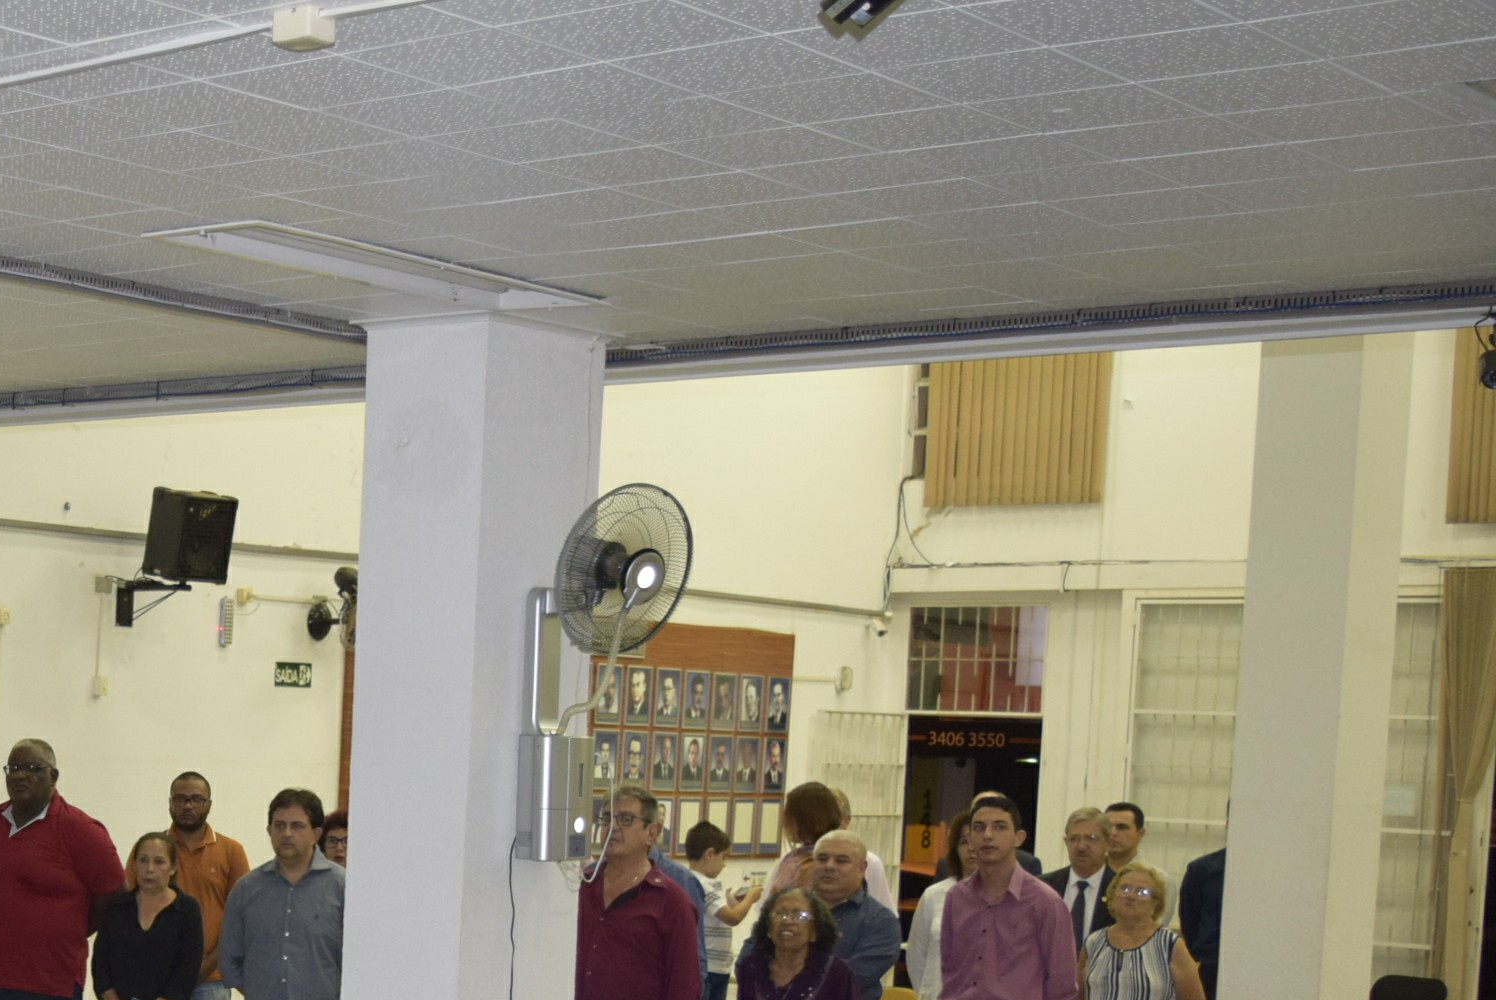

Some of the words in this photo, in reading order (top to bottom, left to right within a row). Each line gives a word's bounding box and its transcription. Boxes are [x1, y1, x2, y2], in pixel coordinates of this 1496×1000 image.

[275, 665, 299, 683] SAÍDA
[928, 731, 965, 746] 3406
[968, 732, 1005, 748] 3550
